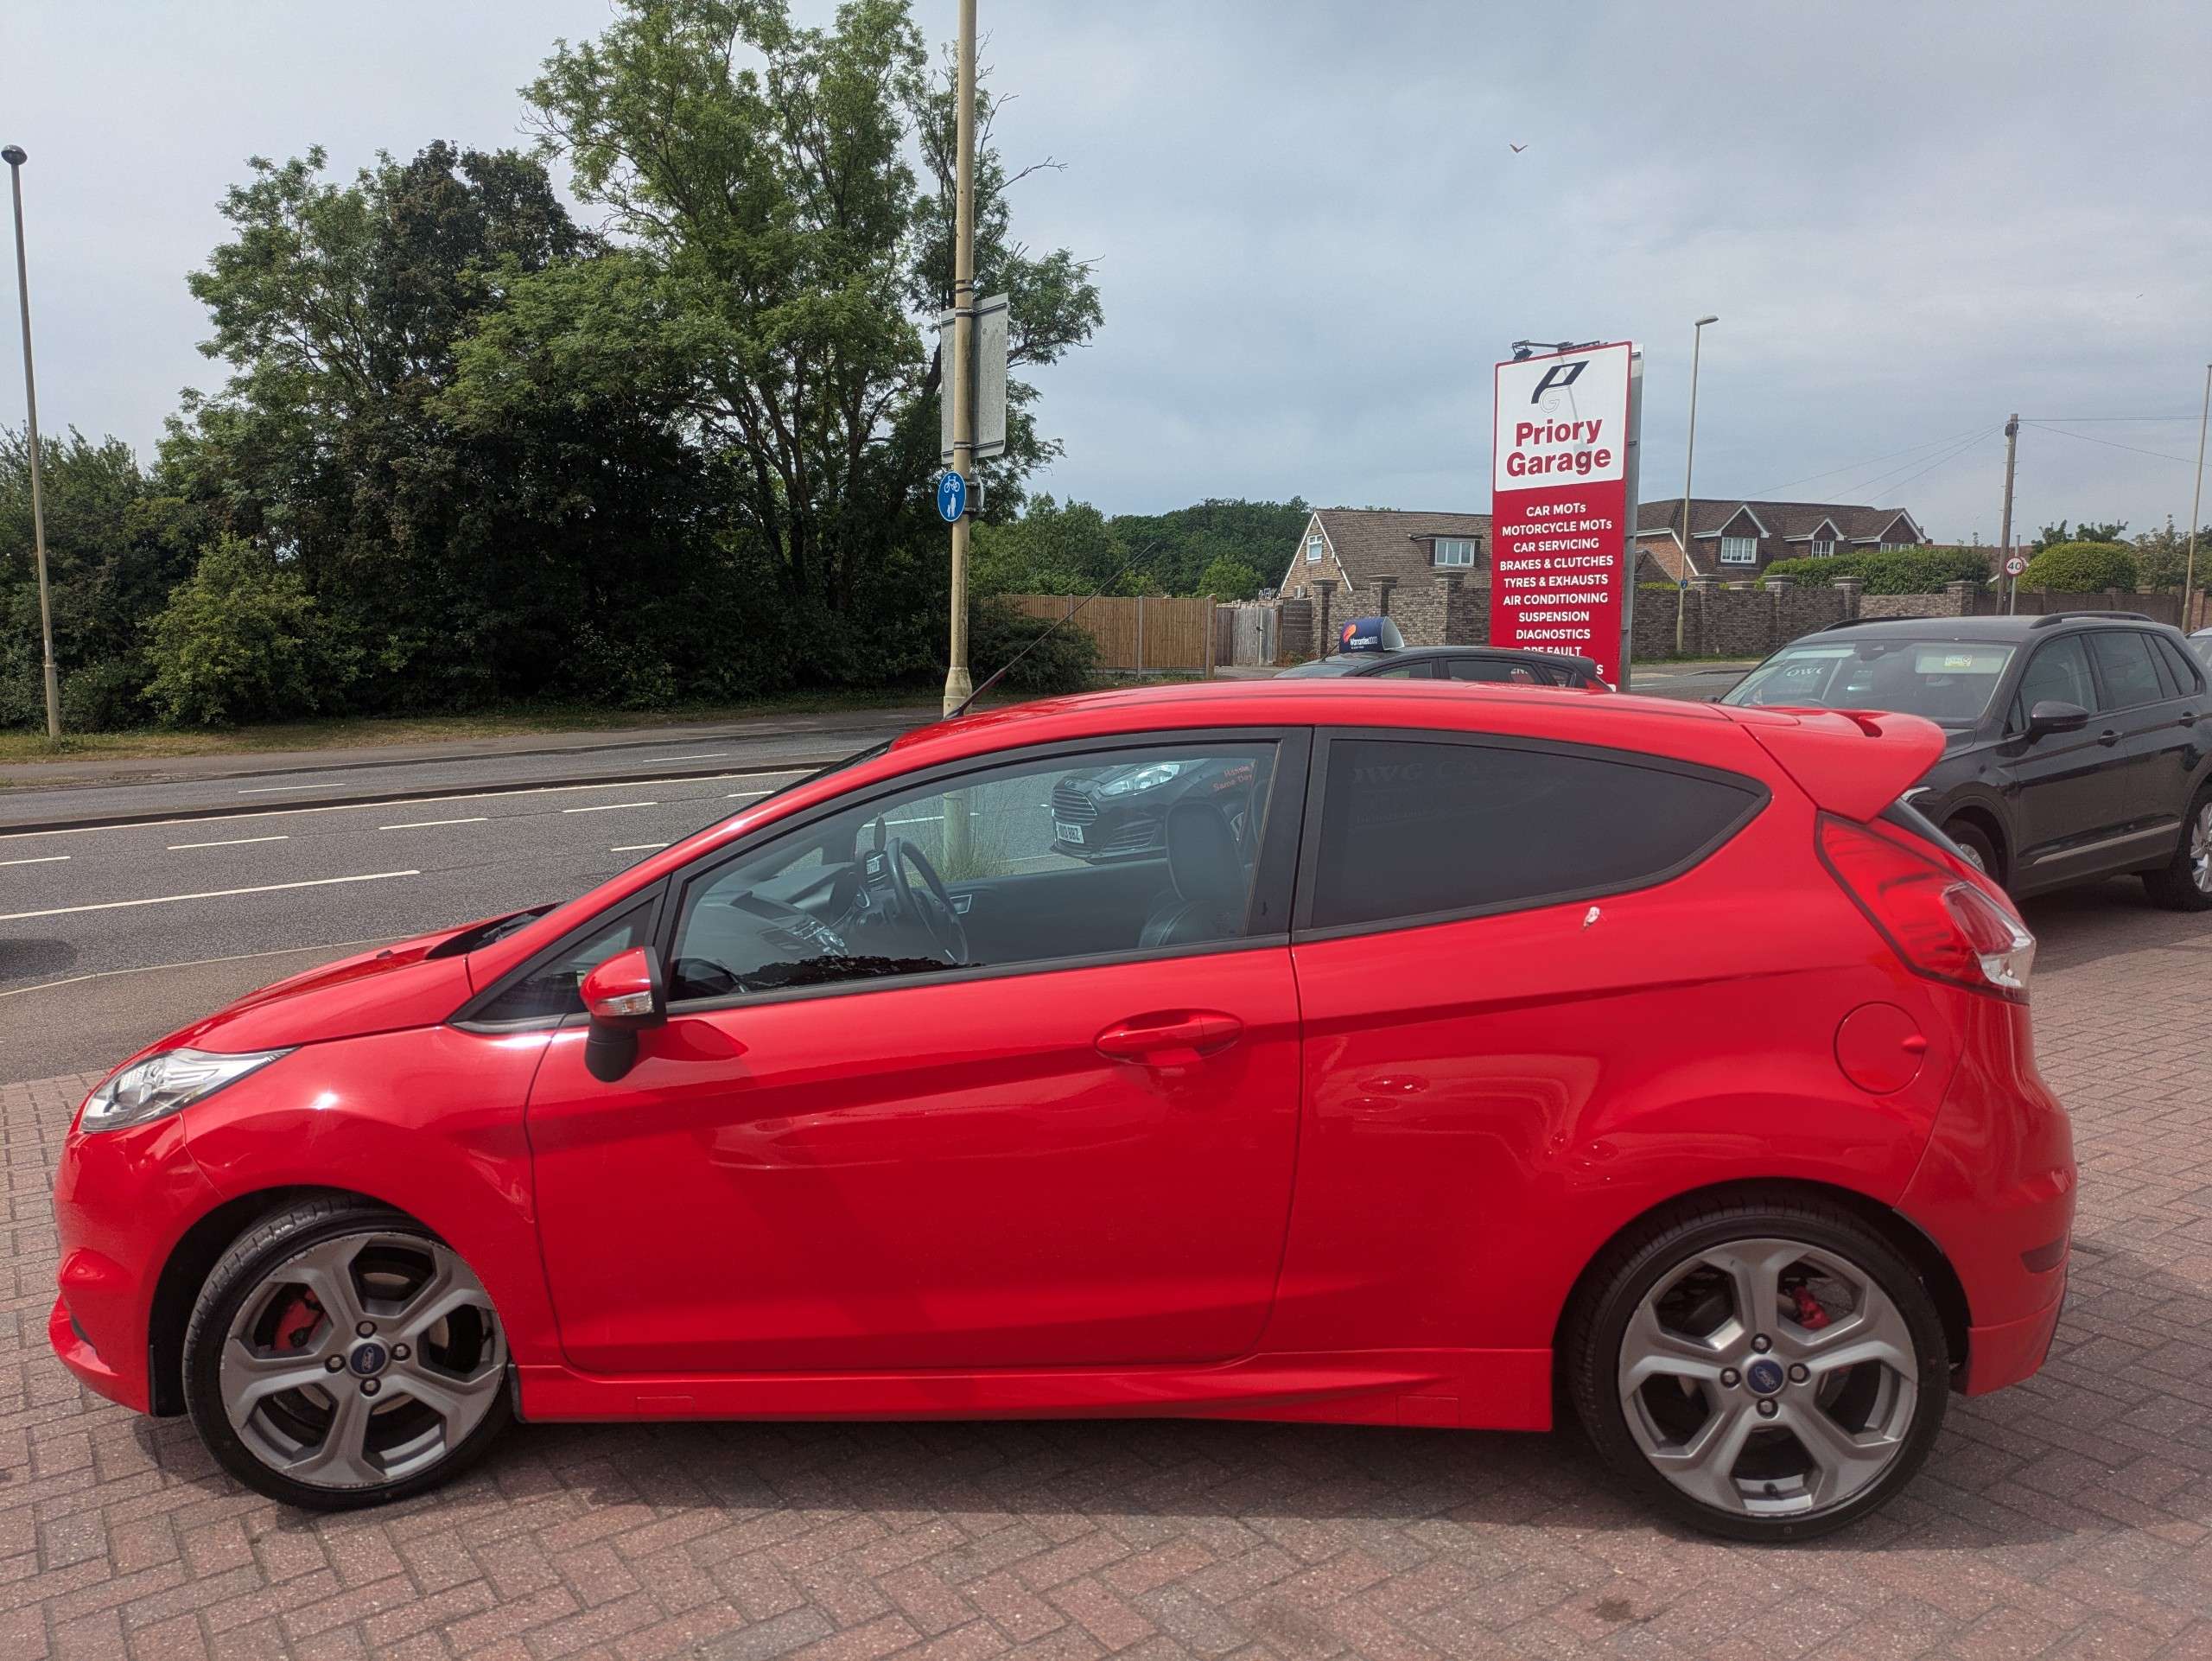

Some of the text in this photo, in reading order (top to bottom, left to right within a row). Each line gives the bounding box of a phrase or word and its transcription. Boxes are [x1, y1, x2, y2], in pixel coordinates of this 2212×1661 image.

[1516, 419, 1603, 447] Priory
[1507, 449, 1611, 477] Garage
[1526, 503, 1586, 517] CAR MOTs
[1502, 519, 1612, 537] MOTORCYCLE MOTs
[1513, 538, 1599, 553] CAR SERVICING
[1500, 555, 1614, 571] BRAKES & CLUTCHES
[2007, 562, 2021, 570] 40
[1503, 574, 1609, 589] TYRES & EXHAUSTS
[1503, 592, 1608, 606] AIR CONDITIONING
[1518, 611, 1590, 622] SUSPENSION
[1516, 628, 1591, 640] DIAGNOSTICS
[1547, 646, 1582, 657] FAULT
